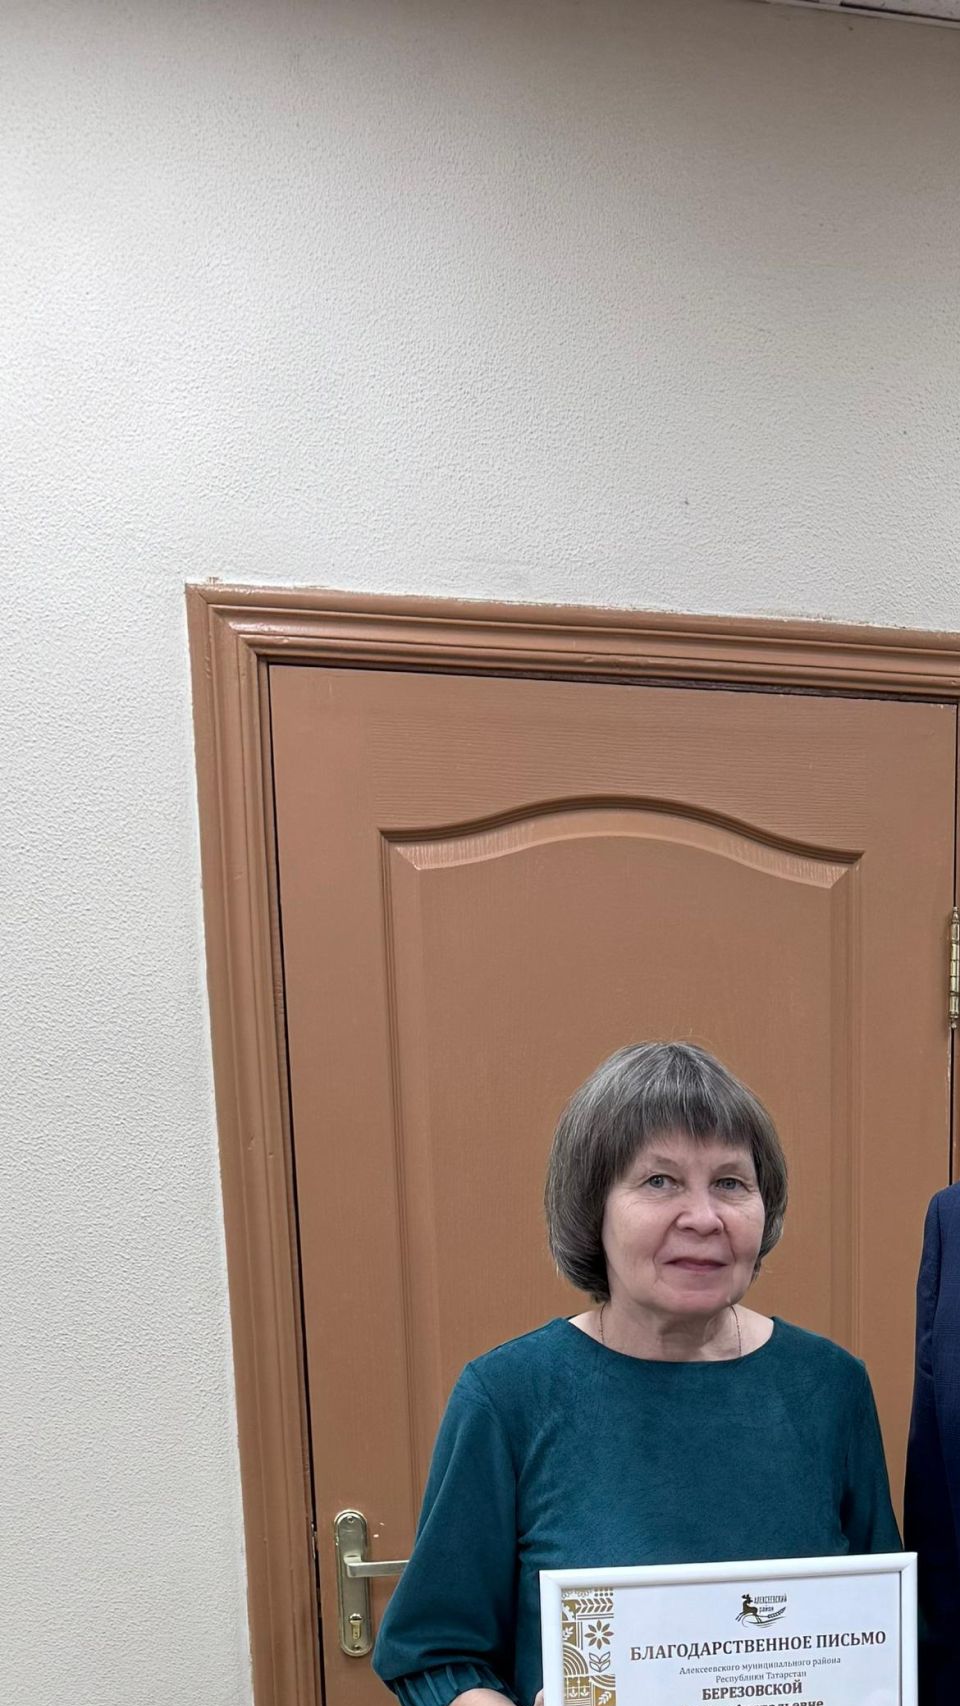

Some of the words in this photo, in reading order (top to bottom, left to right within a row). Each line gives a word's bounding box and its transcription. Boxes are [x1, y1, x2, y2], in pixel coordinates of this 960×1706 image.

[754, 1593, 788, 1604] АЛЕКСЕЕВСКИЙ
[630, 1635, 813, 1661] БЛАГОДАРСТВЕННОЕ
[815, 1631, 887, 1649] ПИСЬМО
[679, 1663, 740, 1675] Алексеевского
[742, 1659, 811, 1673] муниципального
[812, 1656, 841, 1668] района
[715, 1673, 765, 1685] Республики
[766, 1670, 807, 1681] Татарстан
[702, 1679, 803, 1701] БЕРЕЗОВСКОЙ
